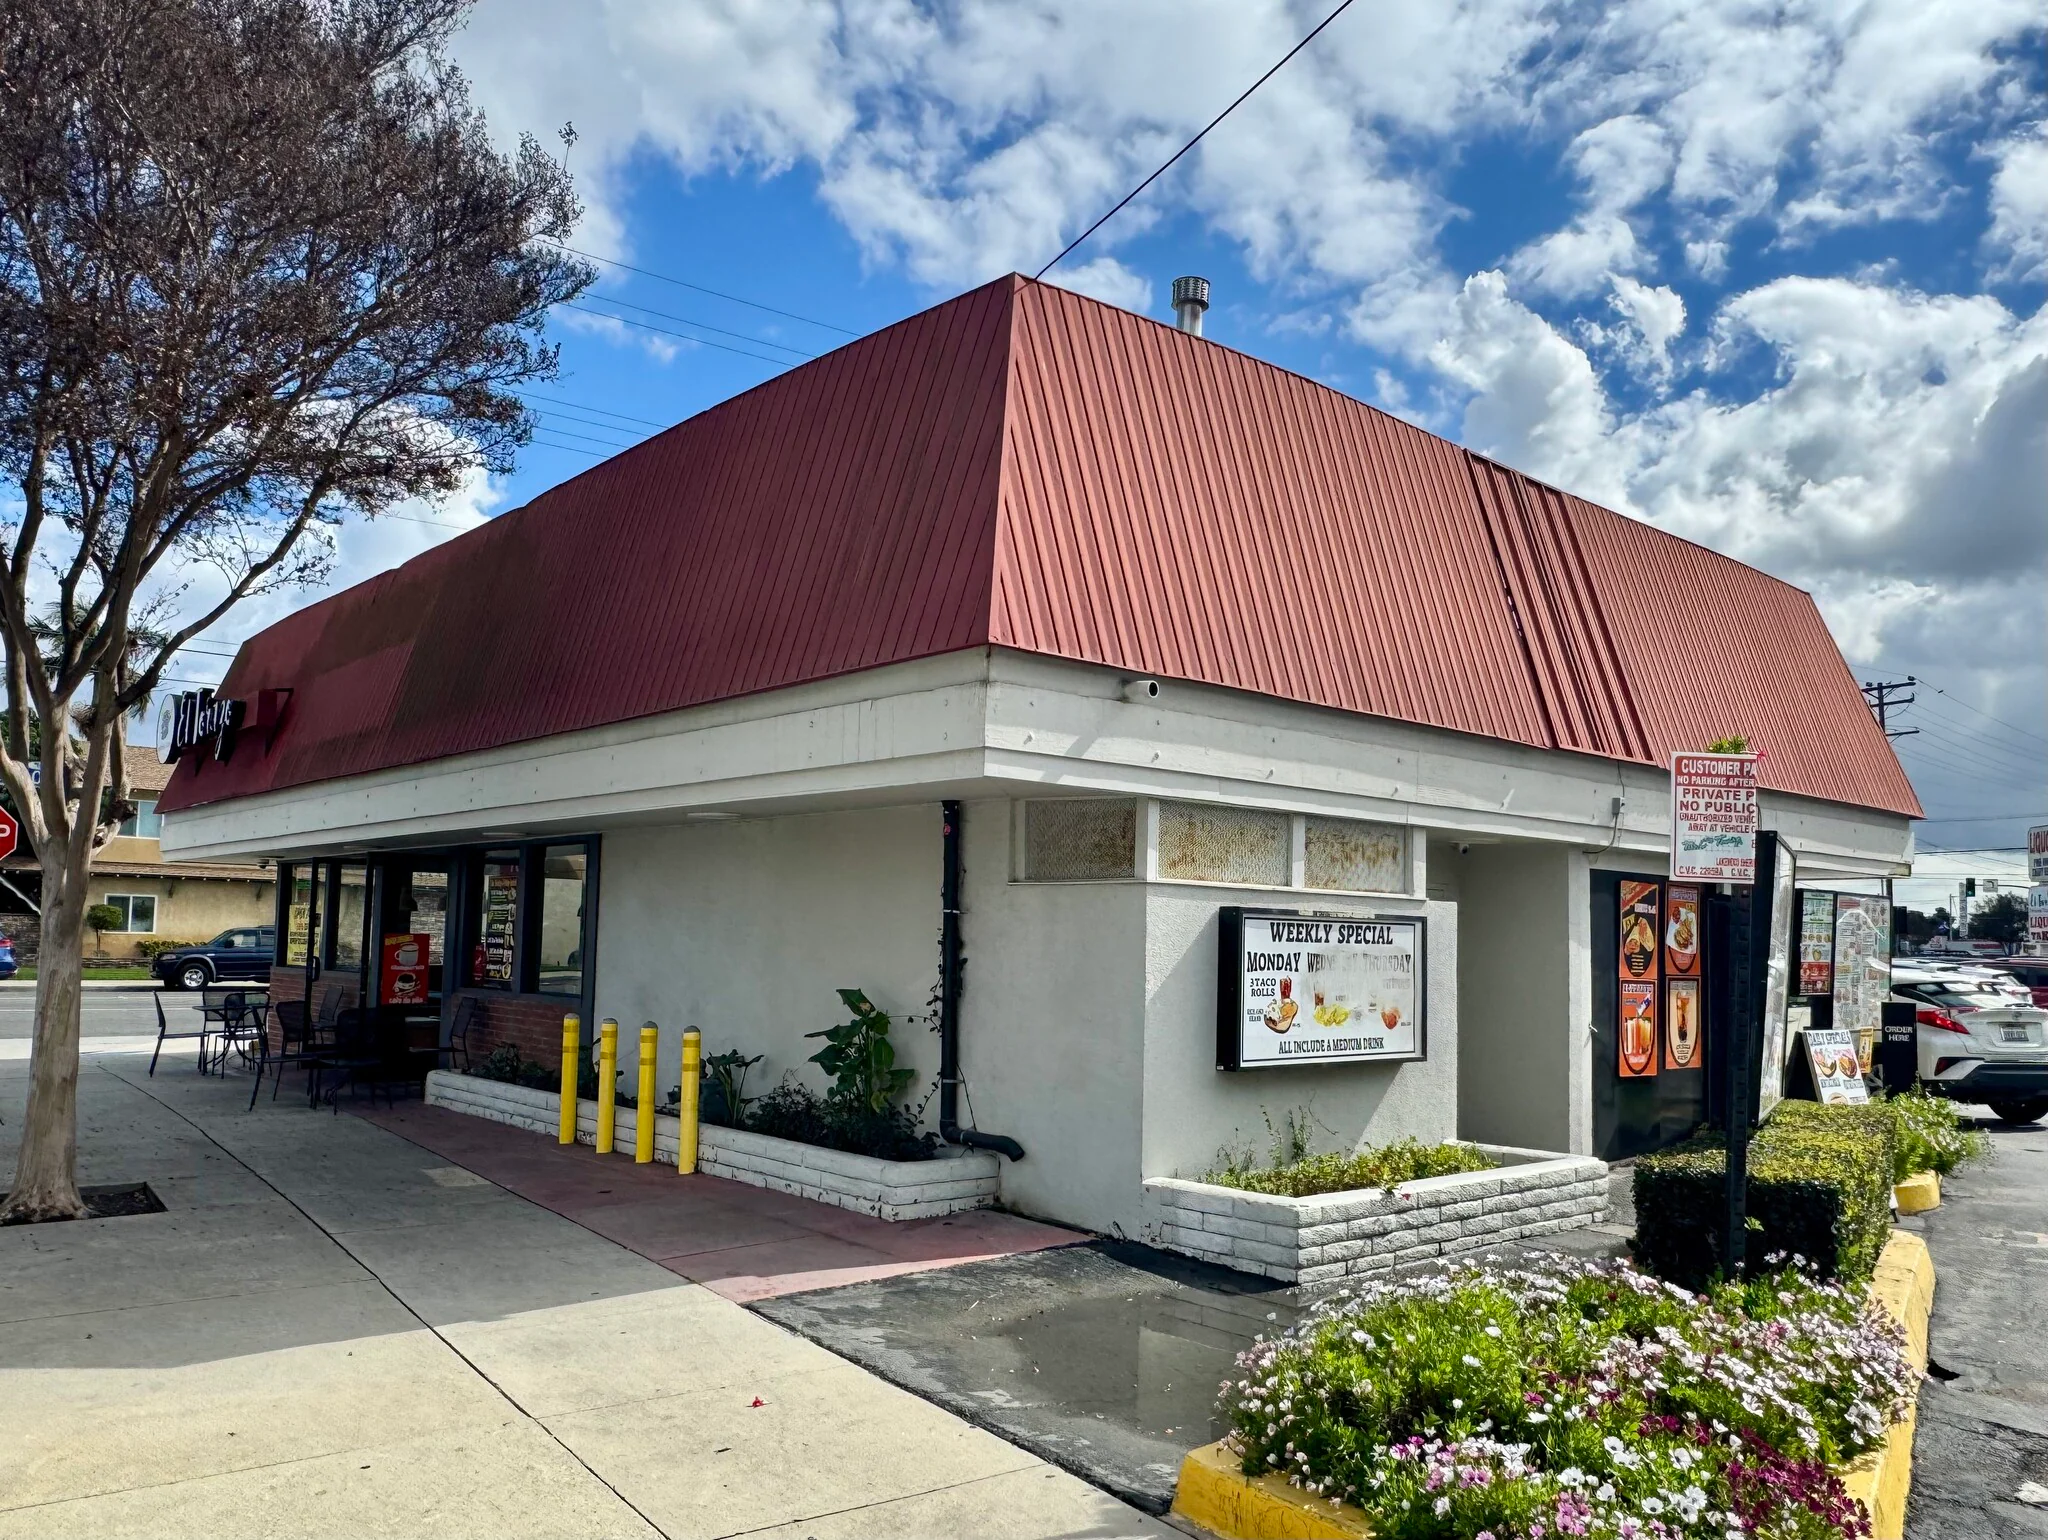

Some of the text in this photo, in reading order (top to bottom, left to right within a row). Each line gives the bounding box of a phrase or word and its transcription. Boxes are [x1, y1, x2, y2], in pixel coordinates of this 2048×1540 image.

[1681, 759, 1740, 775] CUSTOMER
[1676, 775, 1755, 788] NO PARKING AFTER
[1683, 788, 1741, 800] PRIVATE
[1680, 800, 1756, 814] NO PUBLIC
[1709, 824, 1718, 832] AT
[1720, 824, 1749, 833] VEHICLE
[1270, 922, 1393, 945] WEEKLY SPECIAL
[1247, 951, 1301, 972] MONDAY
[1250, 978, 1277, 988] 3 TACO
[1251, 988, 1276, 997] ROLLS
[1888, 1034, 1910, 1042] HERE
[1278, 1037, 1385, 1054] ALL INCLUDE A MEDIUM DRINK
